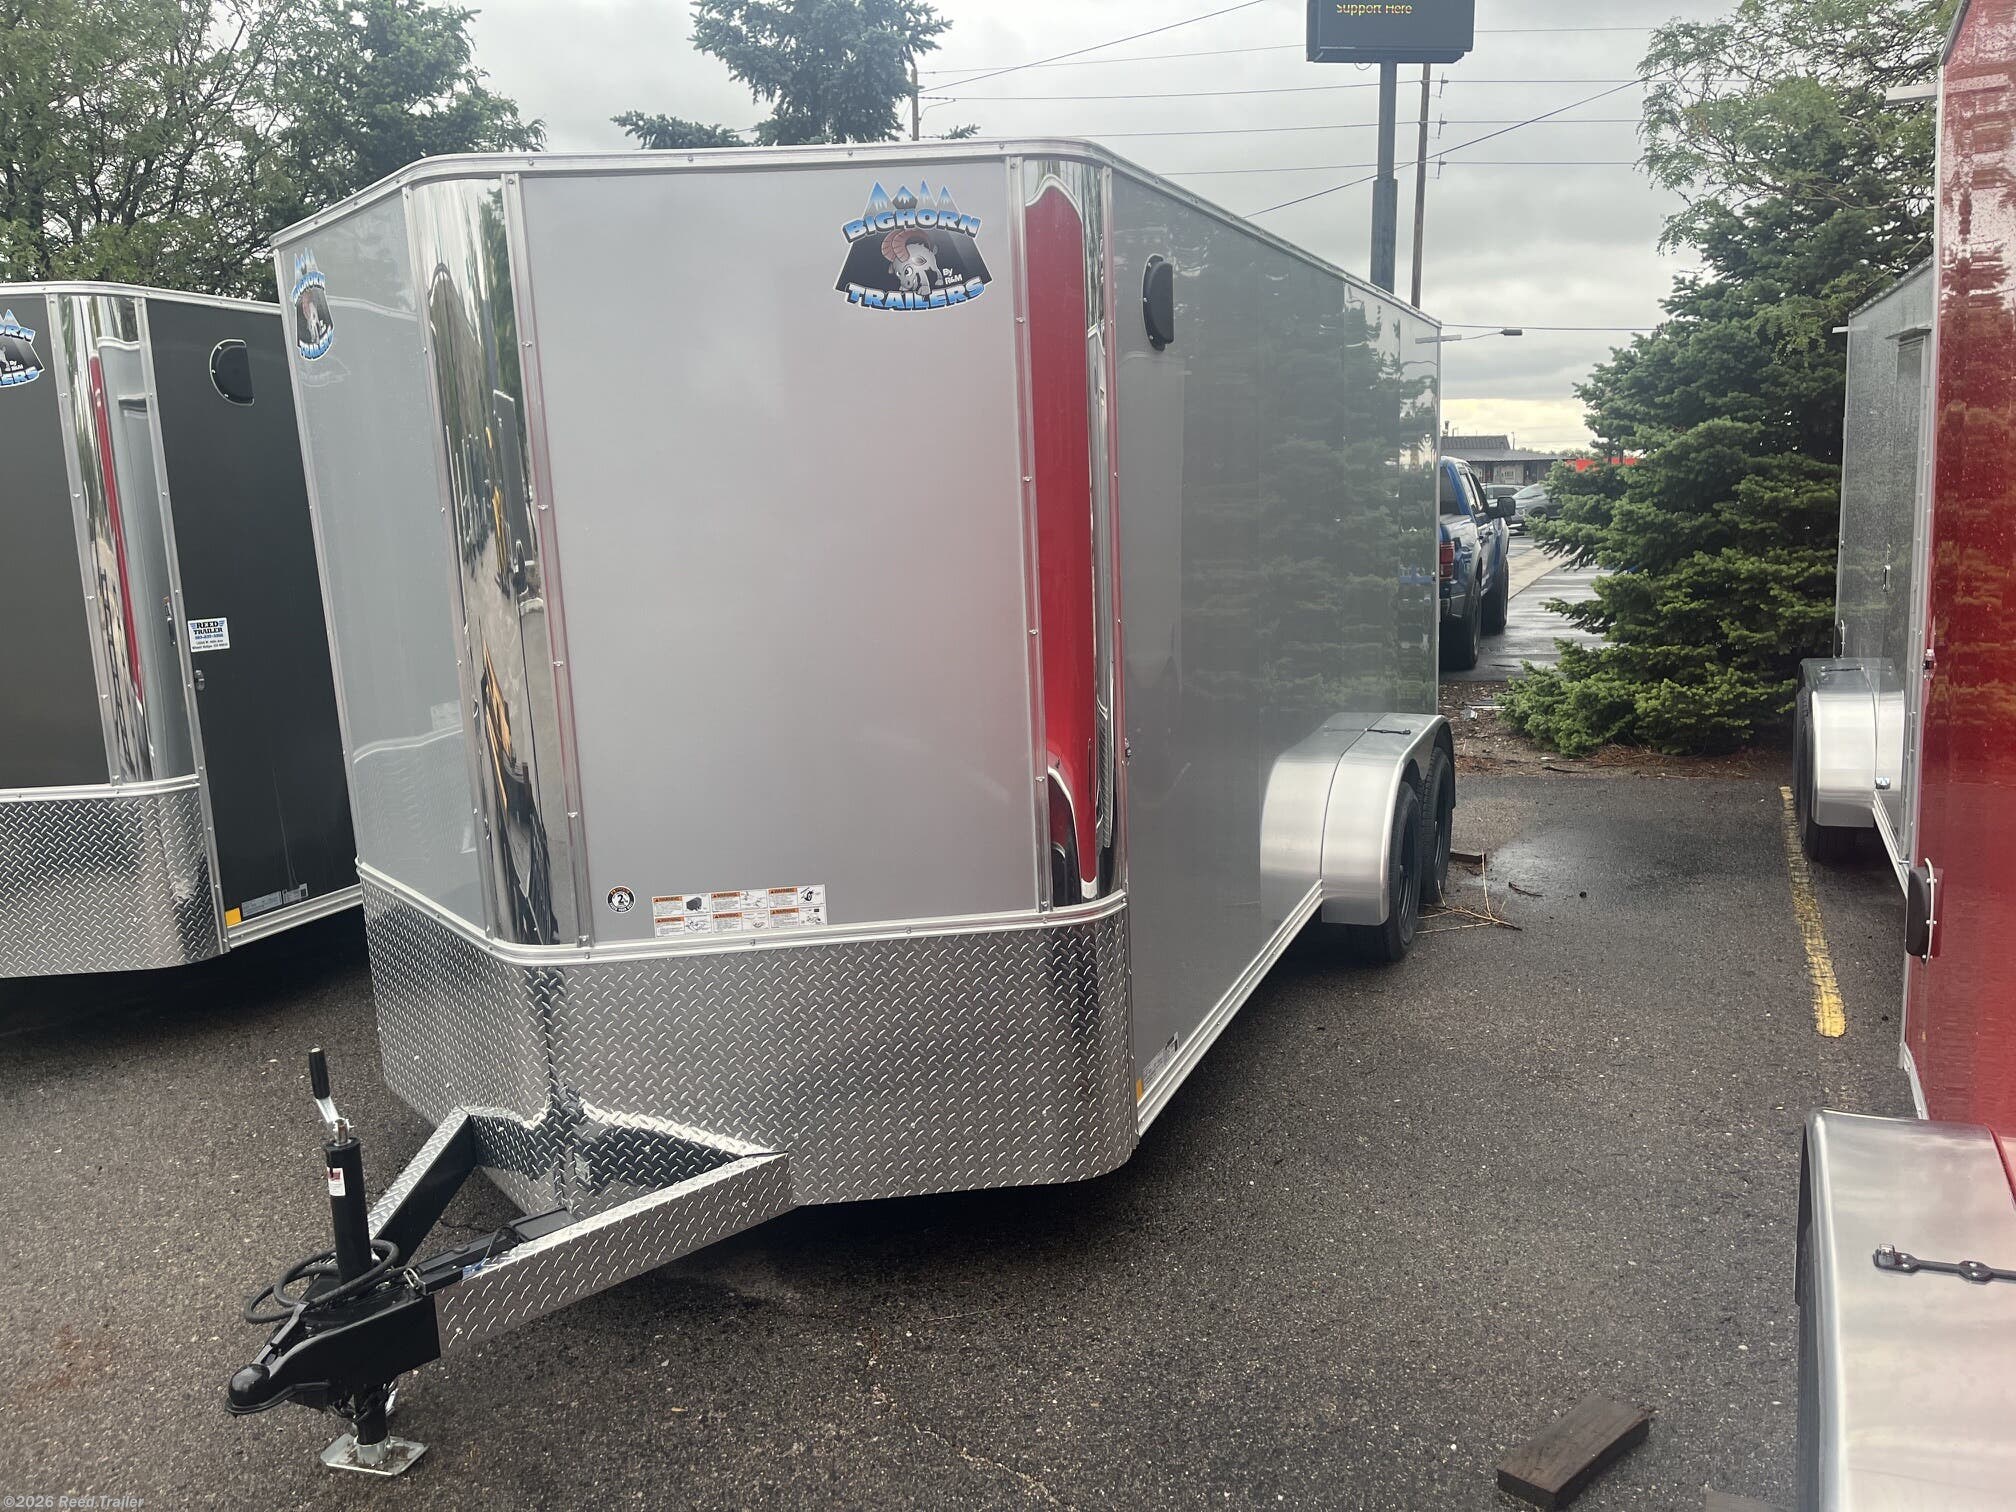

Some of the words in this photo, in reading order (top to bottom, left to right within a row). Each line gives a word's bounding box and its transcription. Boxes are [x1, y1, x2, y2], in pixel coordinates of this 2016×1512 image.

[1385, 4, 1413, 15] Here
[842, 208, 982, 243] BIGHORN
[848, 276, 986, 310] TRAILERS
[196, 621, 219, 629] REED
[193, 627, 223, 635] TRAILER
